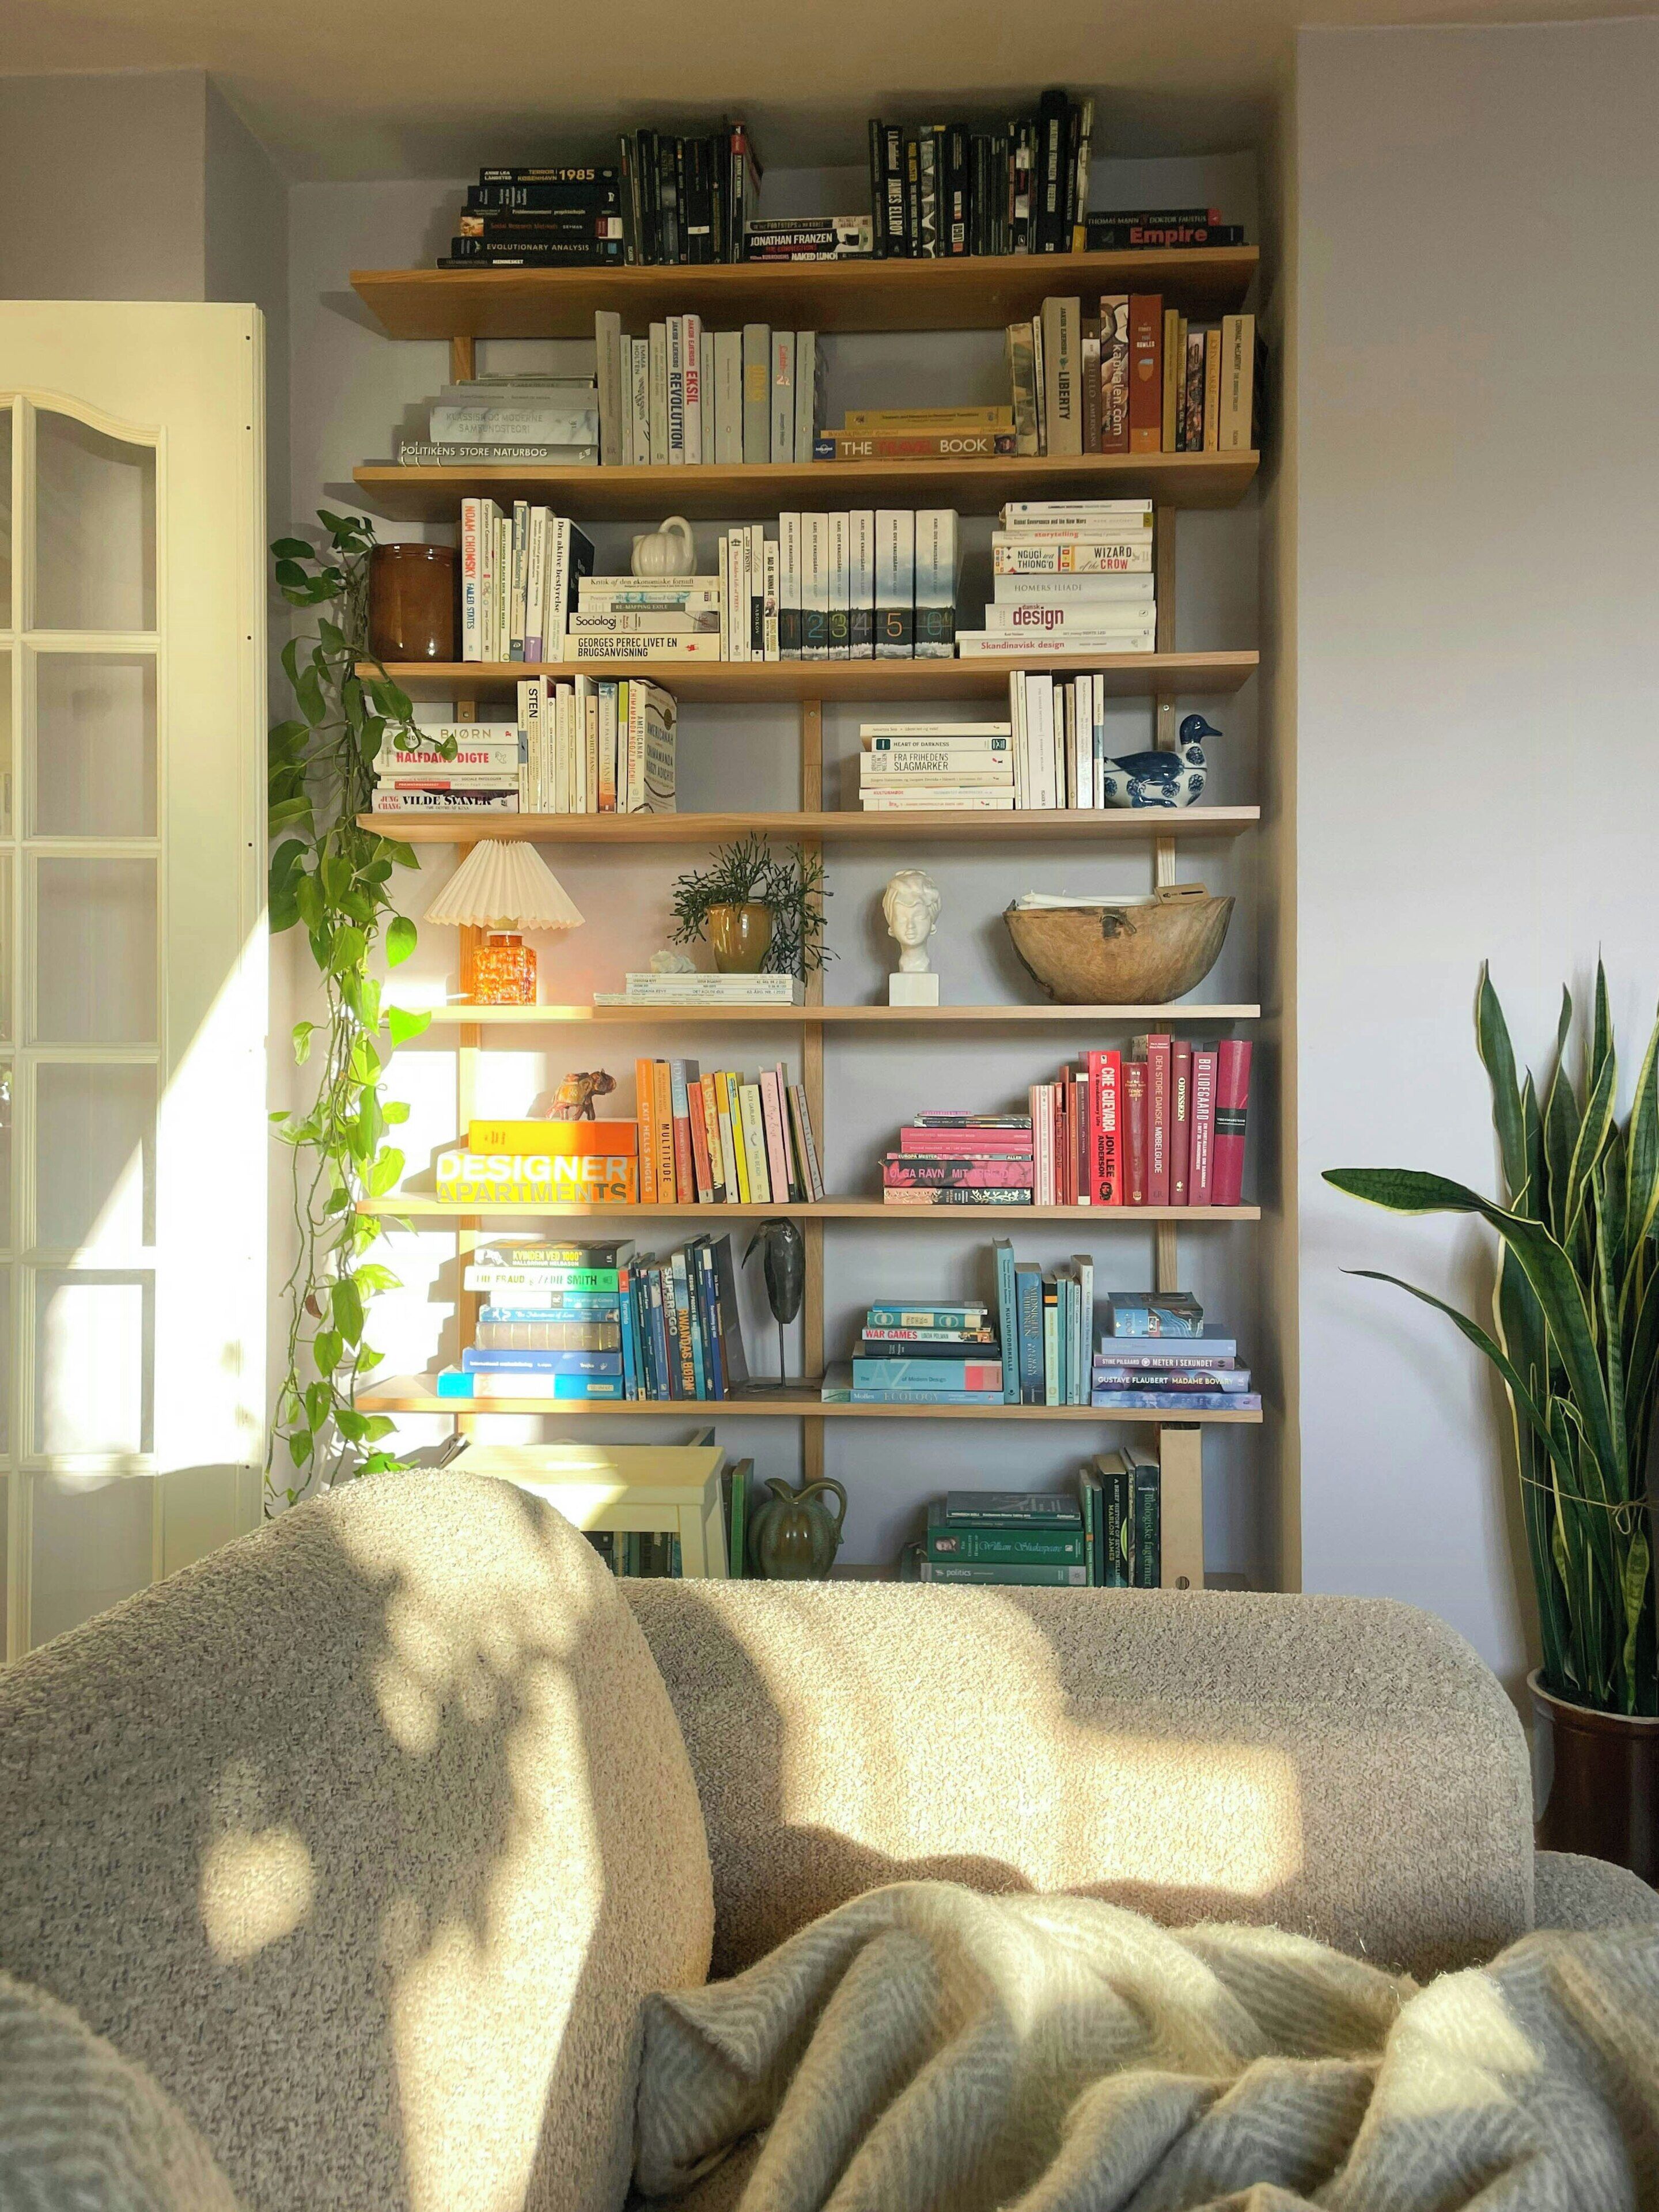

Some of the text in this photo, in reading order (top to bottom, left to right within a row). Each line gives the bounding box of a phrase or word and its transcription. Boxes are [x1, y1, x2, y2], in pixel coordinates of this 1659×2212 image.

[559, 169, 594, 180] 1985
[888, 179, 902, 203] JAMES
[889, 206, 902, 236] ELLROY
[751, 233, 832, 246] JONATHAN FRANZEN
[1130, 226, 1207, 248] Empire
[687, 371, 698, 405] EKSIL
[1059, 372, 1070, 419] LIBERTY
[1113, 344, 1124, 435] kapitalen.com
[671, 373, 682, 449] REVOLUTION
[402, 446, 547, 456] POLITIKENS STORE NATURBOG
[842, 439, 987, 454] THE BOOK
[465, 506, 475, 531] NOAM
[465, 536, 475, 578] CHOMSKY
[1094, 547, 1131, 558] WIZARD
[1089, 559, 1128, 570] the CROW
[555, 569, 563, 612] bestyrelse
[576, 616, 616, 630] Sociologi
[789, 615, 793, 638] 1
[808, 615, 823, 638] 2
[832, 613, 847, 637] 3
[854, 612, 870, 635] 4
[887, 613, 903, 637] 5
[928, 612, 941, 637] 6
[1013, 607, 1063, 630] design
[578, 638, 677, 647] GEORGES PEREC LIVET EN
[578, 648, 647, 657] BRUGSANVISNING
[529, 689, 537, 718] STEN
[458, 753, 488, 763] DIGTE
[895, 762, 948, 771] SLAGMARKER
[403, 796, 440, 805] VILDE
[1101, 1067, 1115, 1132] CHE GUEVARA
[1197, 1059, 1211, 1120] BO LIDEGAARD
[642, 1103, 652, 1192] EXIT HELLS ANGELS
[661, 1124, 671, 1182] MULTITUDE
[1106, 1135, 1114, 1156] JON
[437, 1156, 627, 1181] DESIGNER
[919, 1169, 968, 1177] RAVN MIT
[437, 1183, 626, 1203] APARTMENTS
[513, 1251, 559, 1261] KVINDEN VED
[567, 1275, 597, 1285] SMITH
[665, 1267, 677, 1336] SUPEREGO
[888, 1331, 917, 1339] GAMES
[679, 1309, 694, 1391] RWANDAS BØRN
[884, 1392, 938, 1401] ECOLOGY
[979, 1541, 1062, 1554] William Shakespeare
[1142, 1494, 1155, 1585] Biologiske fagtermer
